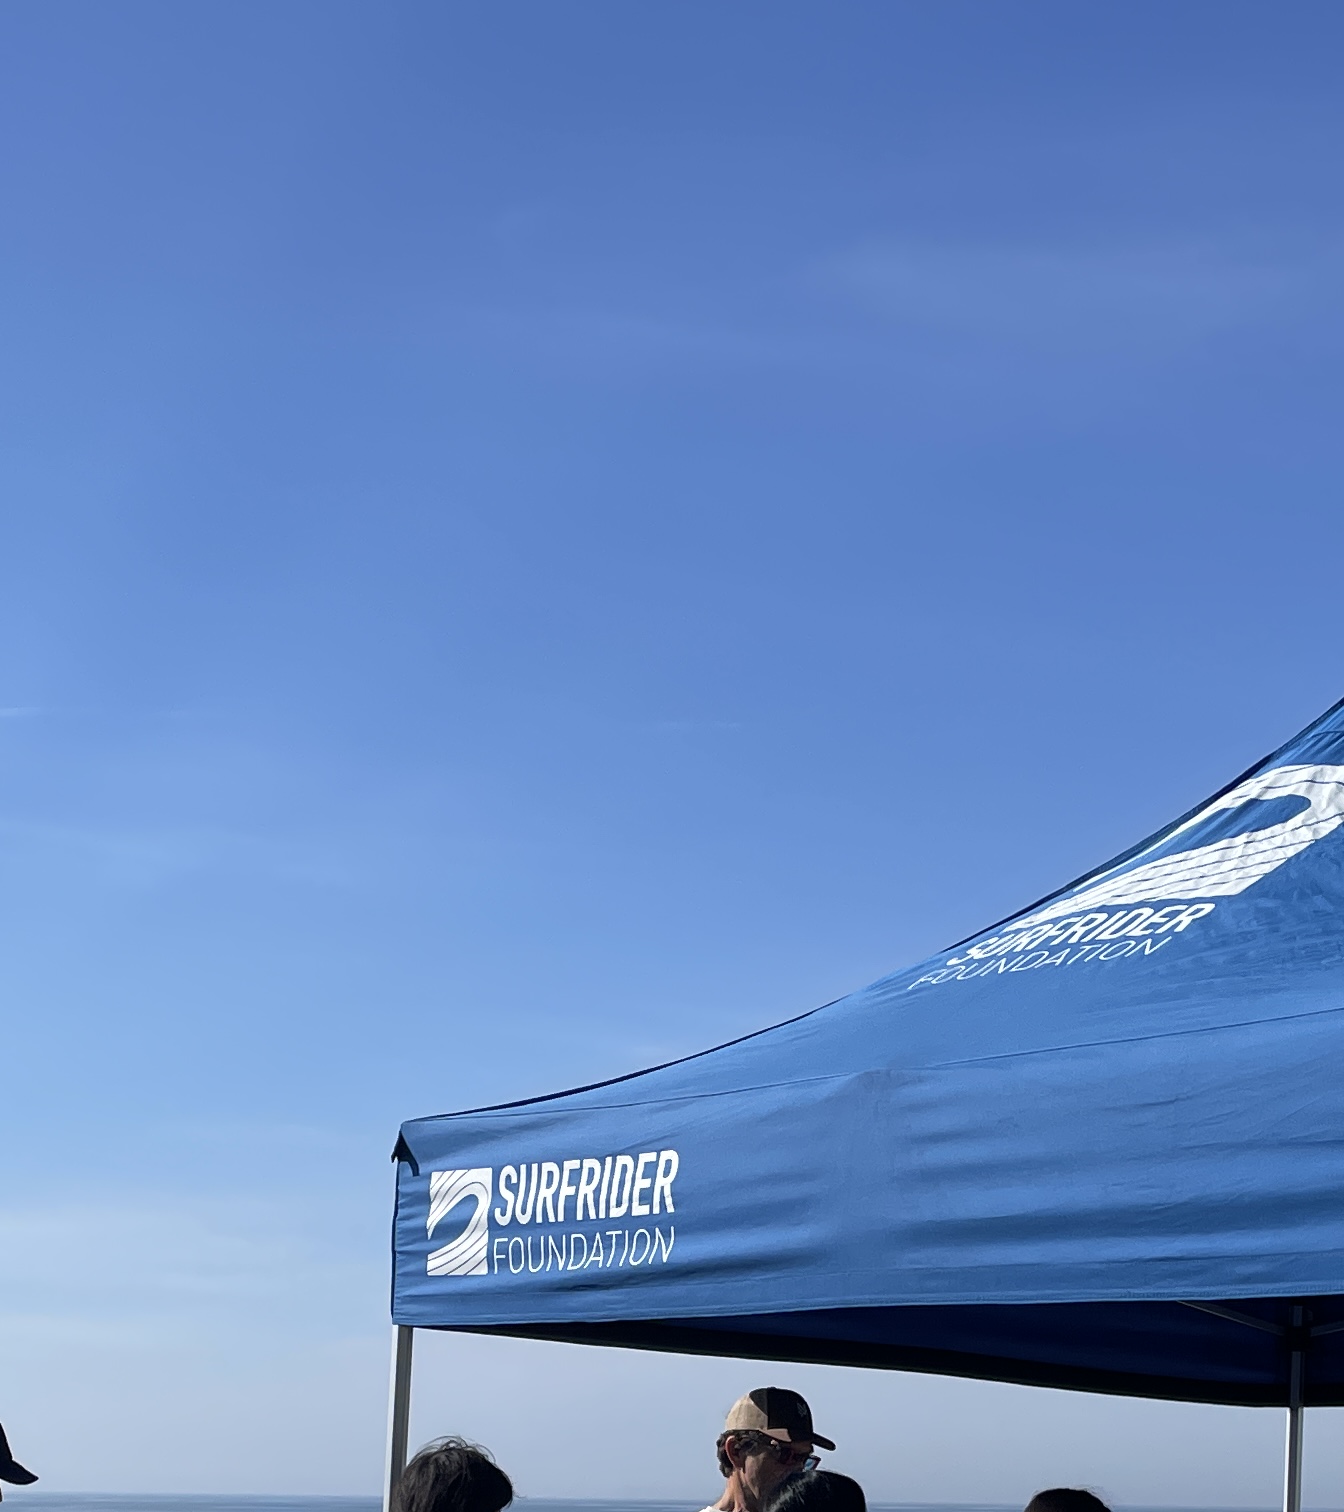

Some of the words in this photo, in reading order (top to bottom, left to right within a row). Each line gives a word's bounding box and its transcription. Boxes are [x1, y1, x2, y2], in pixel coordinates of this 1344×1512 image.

[907, 935, 1173, 991] FOUNDATION
[946, 902, 1216, 966] SURFRIDER
[493, 1149, 680, 1226] SURFRIDER
[492, 1225, 676, 1275] FOUNDATION
